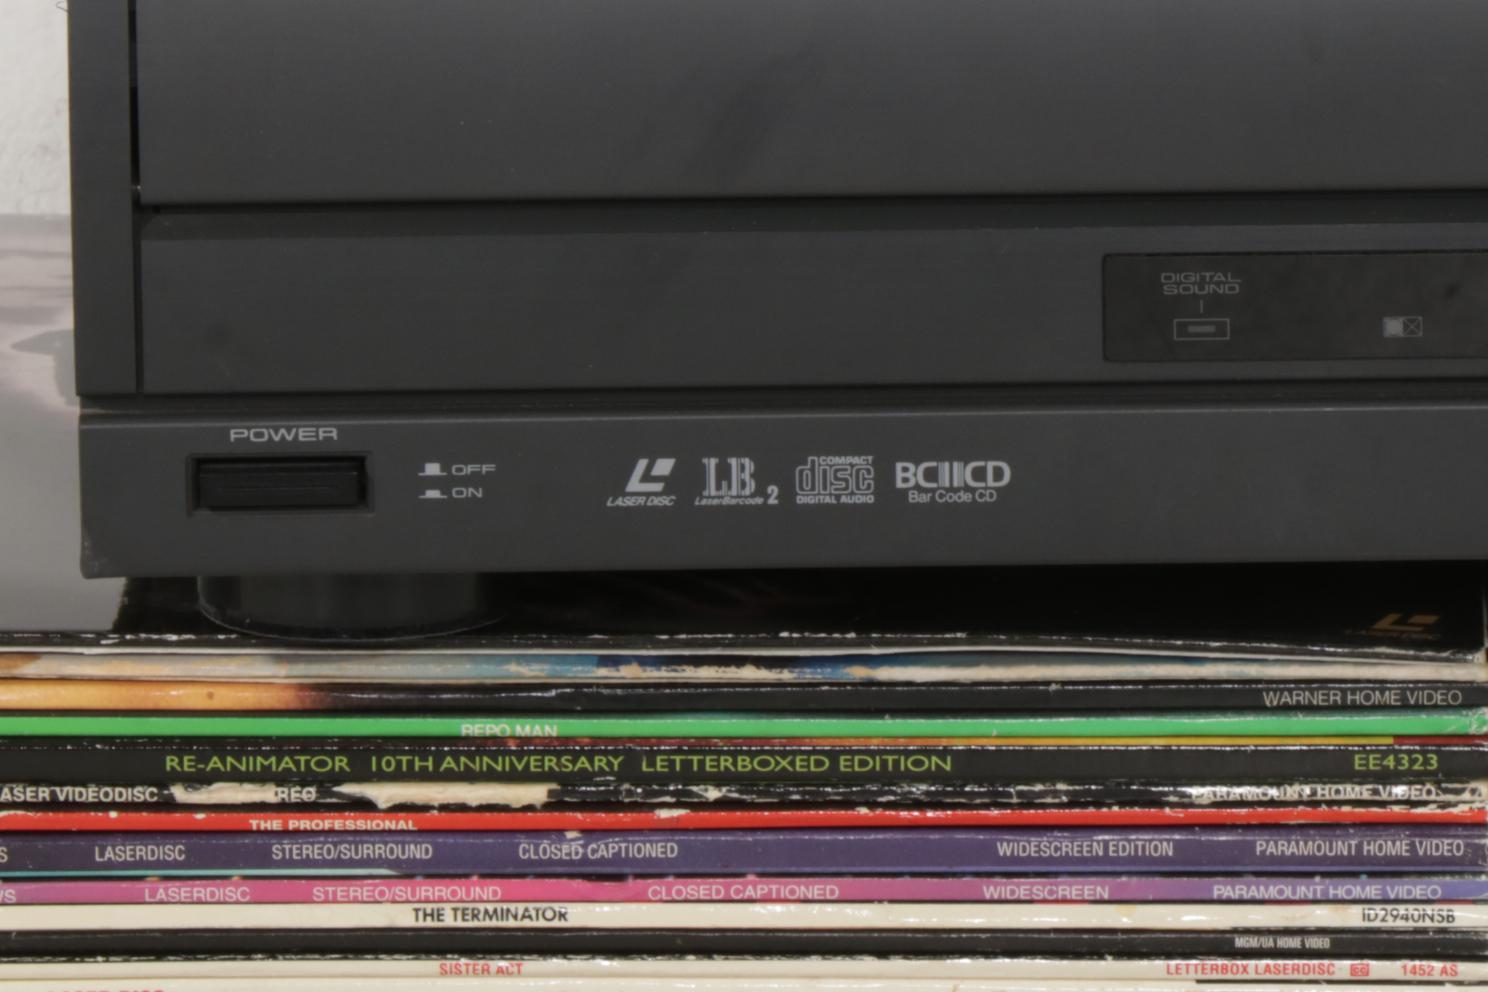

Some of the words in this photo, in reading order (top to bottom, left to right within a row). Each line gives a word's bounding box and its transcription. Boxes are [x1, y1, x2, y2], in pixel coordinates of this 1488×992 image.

[1160, 272, 1242, 283] DIGITAL
[1162, 283, 1241, 295] SOUND
[229, 427, 338, 442] POWER
[819, 455, 875, 466] COMPACT
[451, 464, 496, 476] OFF
[451, 487, 484, 499] ON
[766, 485, 780, 506] 2
[796, 494, 838, 505] DIGITAL
[839, 494, 876, 505] AUDIO
[908, 489, 933, 503] Bar
[935, 489, 973, 503] Code
[975, 488, 998, 503] CD
[606, 495, 647, 507] LASER
[646, 495, 677, 507] DISC
[1262, 690, 1342, 707] WARNER
[1347, 690, 1401, 706] HOME
[1407, 689, 1463, 705] VIDEO
[461, 723, 511, 737] REPO
[515, 723, 558, 737] MAN
[165, 755, 350, 773] RE-ANIMATOR
[371, 756, 434, 772] 10TH
[439, 755, 625, 772] ANNIVERSARY
[641, 755, 830, 772] LETTERBOXED
[839, 755, 952, 772] EDITION
[1354, 754, 1439, 771] EE4323
[54, 786, 159, 802] VIDEODISC
[248, 819, 283, 831] THE
[287, 819, 418, 831] PROFESSIONAL
[94, 845, 186, 862] LASERDISC
[271, 843, 433, 861] STEREO/SURROUND
[518, 843, 583, 860] CLOSED
[587, 842, 679, 859] CAPTIONED
[996, 840, 1104, 858] WIDESCREEN
[1109, 840, 1174, 857] EDITION
[1256, 840, 1358, 857] PARAMOUNT
[1363, 840, 1412, 856] HOME
[1416, 840, 1464, 856] VIDEO
[144, 887, 250, 903] LASERDISC
[312, 885, 501, 902] STEREO/SURROUND
[648, 885, 724, 900] CLOSED
[730, 884, 839, 900] CAPTIONED
[982, 884, 1109, 900] WIDESCREEN
[1213, 884, 1325, 900] PARAMOUNT
[1329, 884, 1382, 900] HOME
[1386, 884, 1441, 899] VIDEO
[412, 907, 445, 922] THE
[450, 906, 569, 922] TERMINATOR
[1361, 907, 1456, 923] ID2940NSB
[1234, 936, 1274, 949] MGM/UA
[1277, 936, 1303, 949] HOME
[1304, 936, 1330, 949] VIDEO
[439, 962, 491, 976] SISTER
[496, 962, 523, 976] ACT
[1166, 962, 1249, 976] LETTERBOX
[1254, 962, 1335, 976] LASERDISC
[1401, 963, 1434, 976] 1452
[1440, 963, 1459, 976] AS
